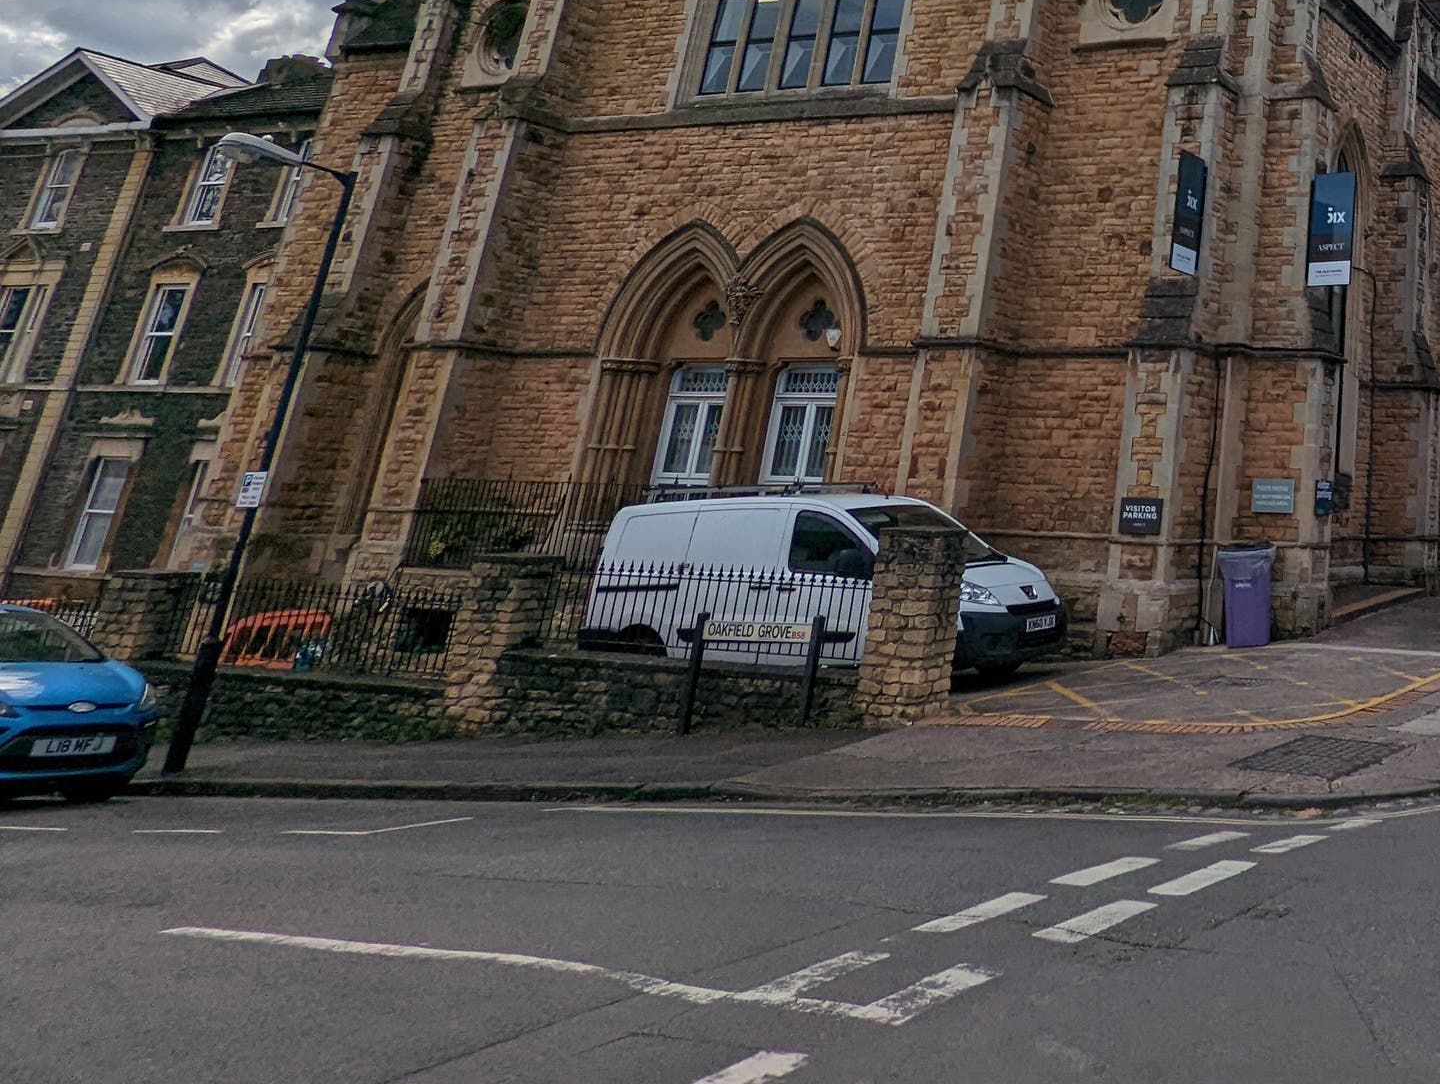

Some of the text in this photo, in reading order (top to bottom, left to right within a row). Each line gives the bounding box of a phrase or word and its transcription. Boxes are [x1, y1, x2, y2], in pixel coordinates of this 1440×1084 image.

[1317, 243, 1345, 251] ASPECT
[1126, 505, 1157, 513] VISITOR
[1123, 511, 1158, 520] PARKING
[708, 623, 806, 639] OAKFIELD GROVE BS8
